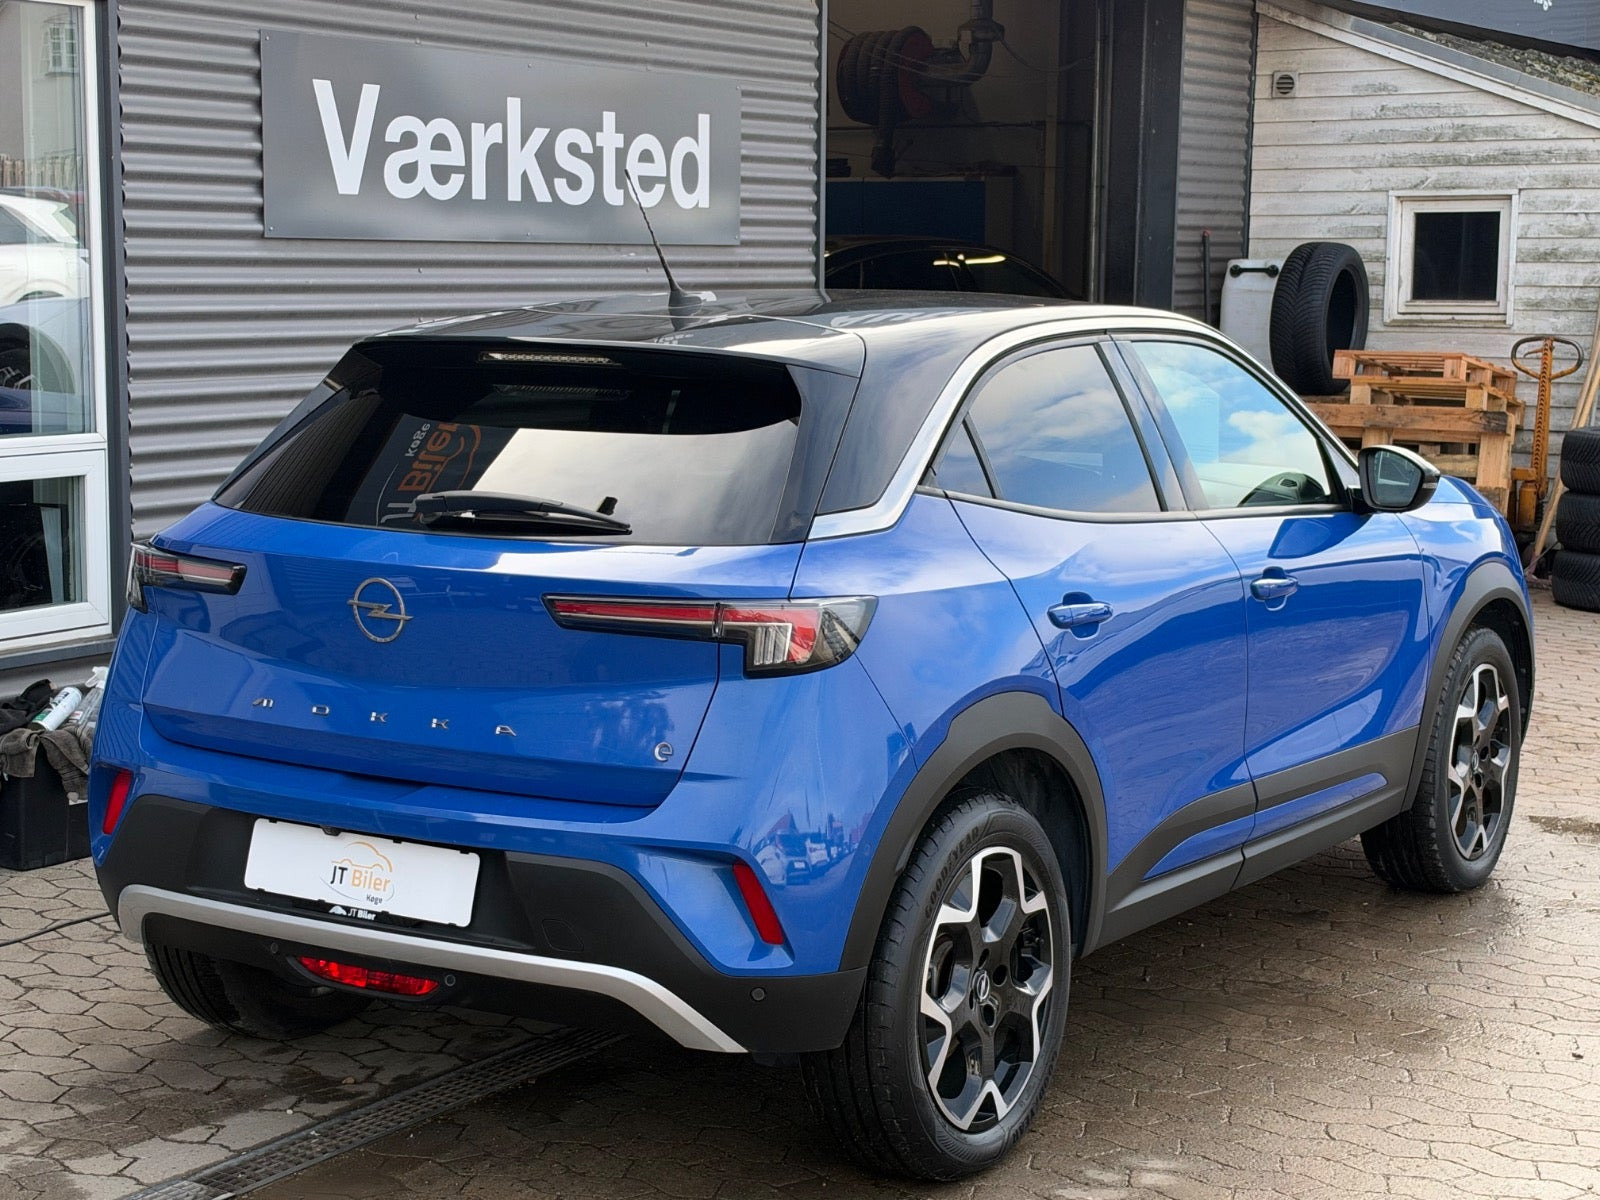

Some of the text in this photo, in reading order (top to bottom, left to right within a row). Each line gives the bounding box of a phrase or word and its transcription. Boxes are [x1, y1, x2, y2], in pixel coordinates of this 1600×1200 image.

[312, 79, 710, 209] Værksted
[252, 697, 517, 737] MOKKA
[330, 865, 391, 892] JT Biler
[924, 826, 980, 919] GOODYEAR
[347, 908, 376, 920] JT Biler
